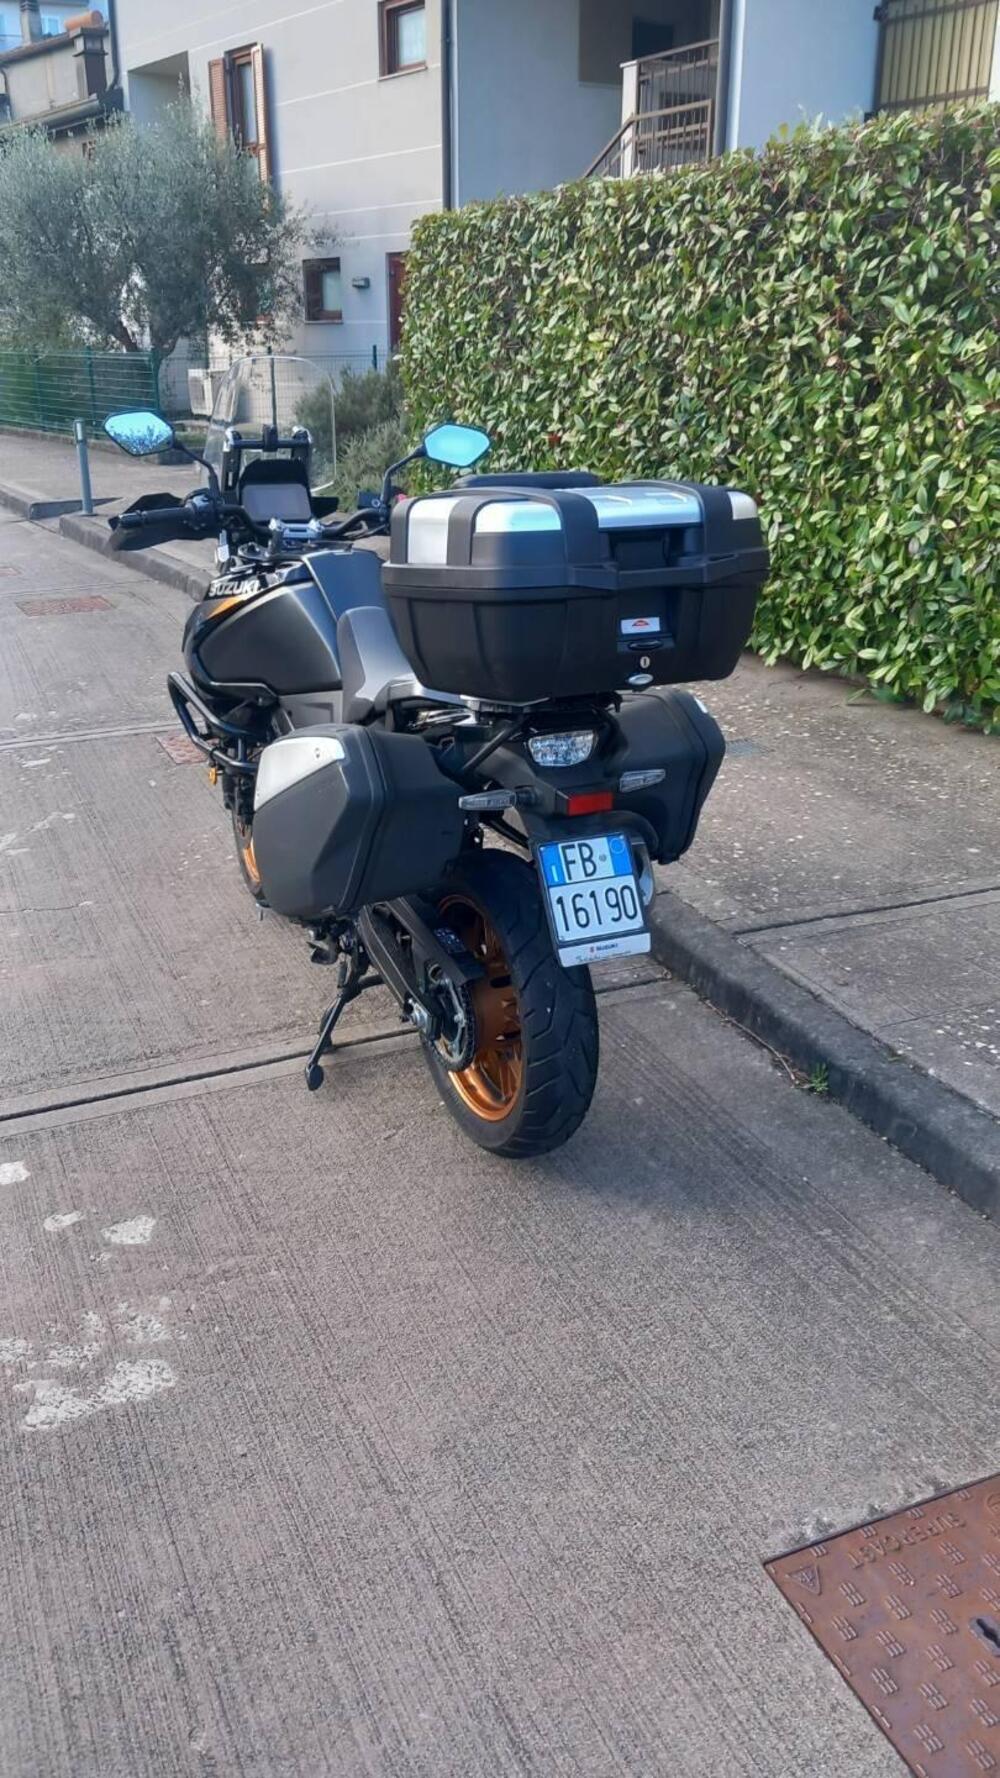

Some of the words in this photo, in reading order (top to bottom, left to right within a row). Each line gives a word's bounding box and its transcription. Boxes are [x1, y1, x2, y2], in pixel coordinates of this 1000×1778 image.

[208, 579, 260, 597] SUZUKI
[561, 842, 597, 881] FB
[556, 885, 638, 932] 16190
